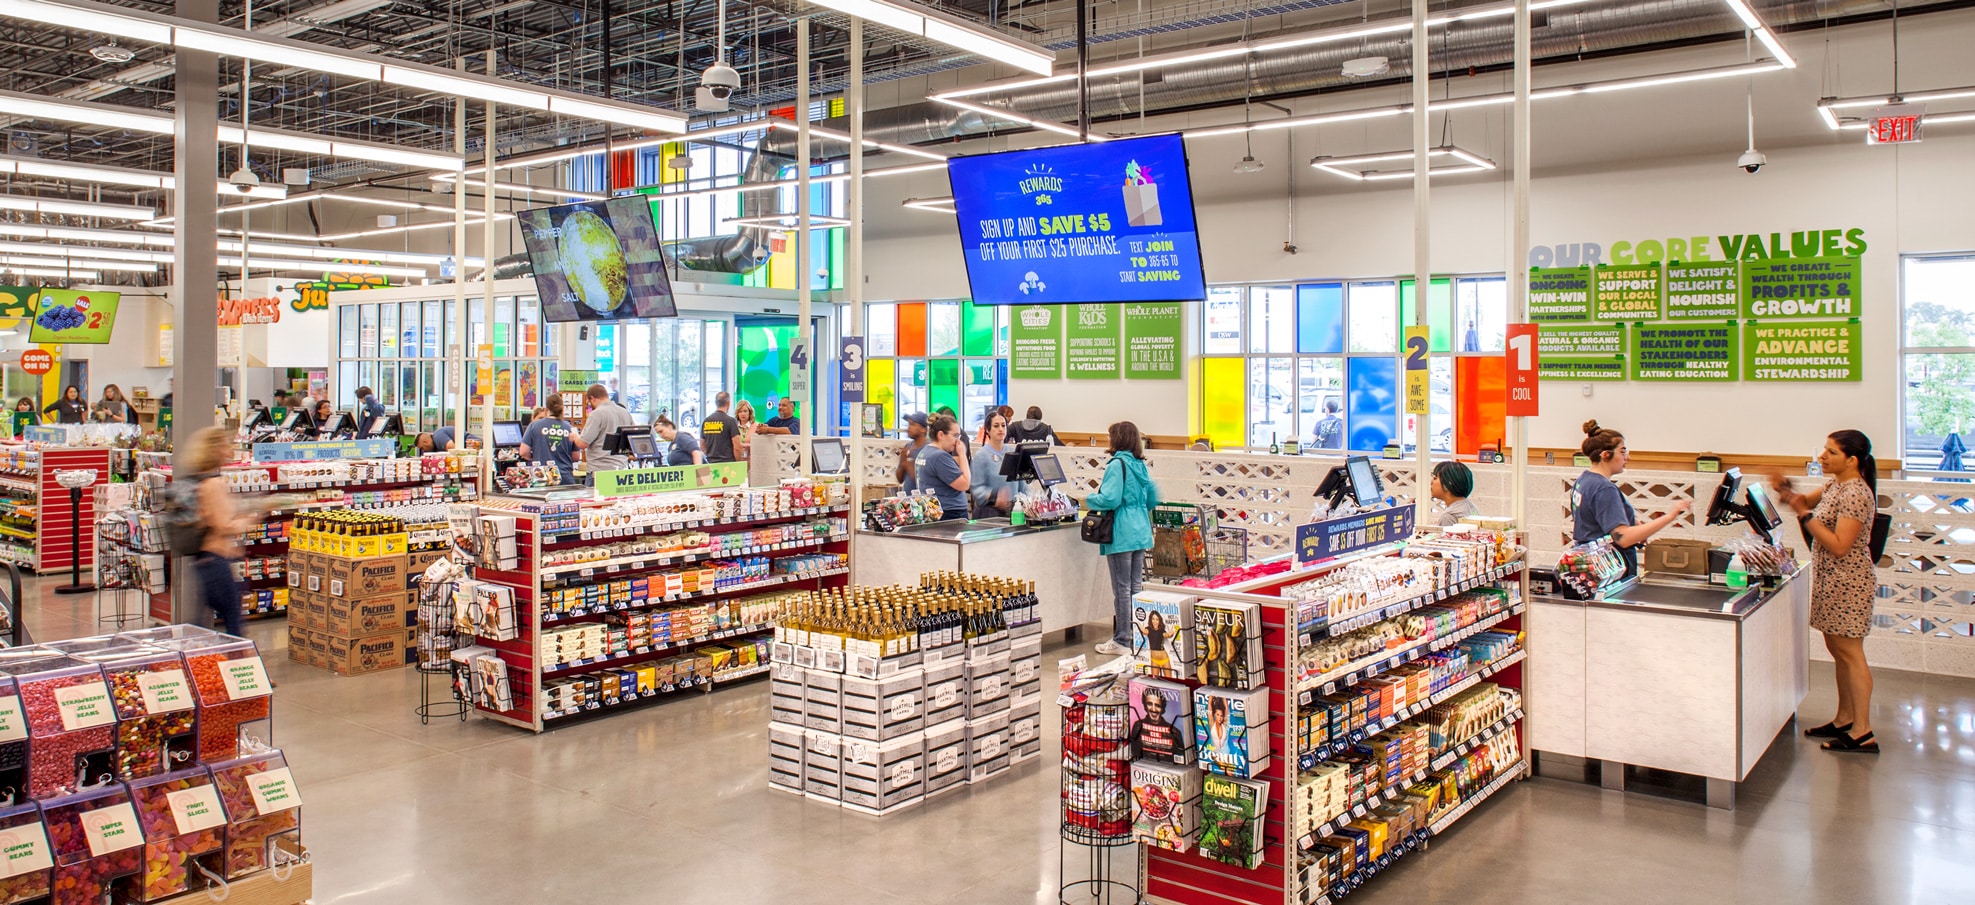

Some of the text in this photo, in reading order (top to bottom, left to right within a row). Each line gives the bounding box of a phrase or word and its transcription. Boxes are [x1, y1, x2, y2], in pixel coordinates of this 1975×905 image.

[1878, 117, 1915, 142] EXIT
[1019, 176, 1062, 194] REWARDS
[1036, 194, 1052, 205] 365
[980, 213, 1110, 239] SIGN UP AND SAVE $5
[534, 227, 561, 239] PEPPER
[980, 235, 1121, 261] OFF YOUR FIRST $25 PURCHASE.
[1129, 240, 1174, 253] TEXT JOIN
[1529, 228, 1867, 268] OUR CORE VALUES
[1130, 254, 1178, 268] TO 365-65 TO
[1790, 263, 1830, 271] CREATE
[1120, 270, 1180, 282] START SAVING
[1617, 271, 1647, 279] SERVE
[1669, 270, 1686, 278] WE
[1752, 272, 1851, 282] WEALTH THROUGH
[1530, 280, 1587, 290] ONGOING
[1599, 280, 1657, 290] SUPPORT
[1669, 280, 1736, 291] DELIGHT &
[1752, 283, 1850, 298] PROFITS &
[562, 292, 579, 302] SALT
[1530, 292, 1586, 303] WIN-WIN
[1623, 291, 1657, 299] LOCAL
[1670, 294, 1736, 306] NOURISH
[76, 299, 90, 308] SALE
[1610, 302, 1656, 310] GLOBAL
[1752, 298, 1850, 315] GROWTH
[1127, 305, 1151, 316] WHOLE
[1778, 328, 1836, 337] PRACTICE
[1640, 340, 1682, 348] HEALTH
[1755, 340, 1849, 354] ADVANCE
[791, 345, 807, 370] 4
[843, 344, 862, 370] 3
[1131, 351, 1138, 362] IN
[1140, 351, 1150, 361] THE
[1407, 336, 1428, 370] 2
[1509, 334, 1531, 370] 1
[1640, 351, 1728, 359] STAKEHOLDERS
[479, 350, 492, 370] 5
[1755, 369, 1850, 378] STEWARDSHIP
[792, 382, 805, 390] SUPER
[843, 382, 863, 391] SMILING
[1411, 385, 1424, 396] AWE-
[1512, 388, 1531, 400] COOL
[1410, 399, 1424, 411] SOME
[542, 427, 569, 437] GOOD
[616, 471, 684, 485] WE DELIVER!
[1329, 532, 1339, 552] SAVE
[1340, 533, 1346, 550] $5
[1355, 529, 1365, 546] YOUR
[1366, 526, 1377, 543] FIRST
[362, 566, 395, 577] PACIFICO
[477, 590, 497, 600] PALEO
[362, 604, 395, 616] PACIFICO
[1195, 610, 1244, 627] SAVEUR
[361, 642, 393, 654] PACIFICO
[149, 682, 180, 690] ASSORTED
[61, 695, 105, 706] STRAWBERRY
[937, 690, 954, 700] HARTHILL
[892, 704, 913, 712] HARTHILL
[1199, 745, 1246, 769] Beauty
[259, 780, 286, 789] ORGANIC
[1134, 770, 1179, 788] ORIGINS
[262, 787, 285, 796] GUMMY
[1205, 779, 1236, 798] dwell
[265, 794, 289, 802] WORMS
[186, 802, 204, 810] FRUIT
[187, 808, 209, 817] SLICES
[100, 821, 122, 830] SUPER
[103, 829, 125, 837] STARS
[3, 842, 34, 853] GUMMY
[9, 850, 33, 860] BEARS
